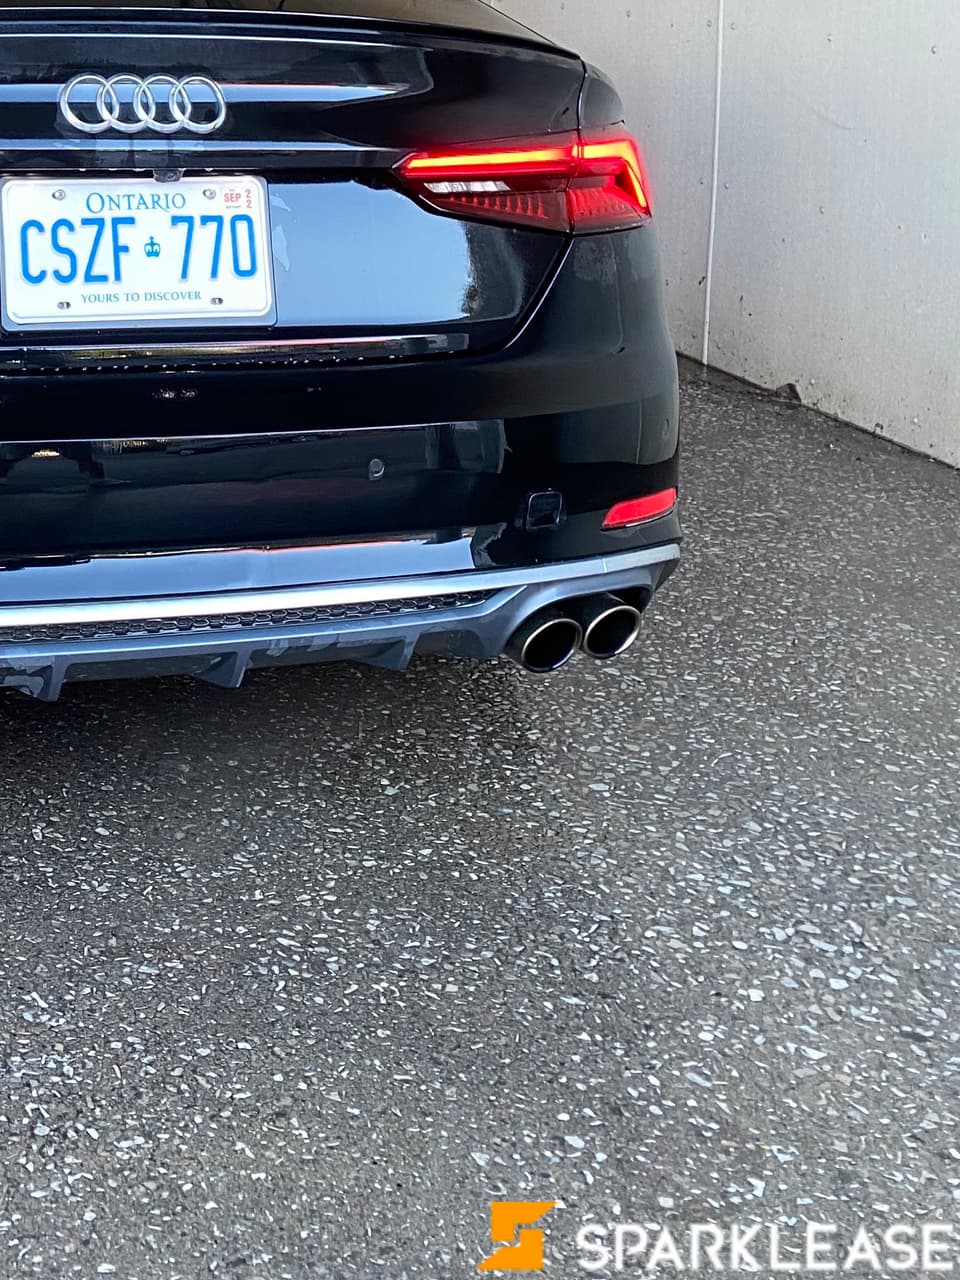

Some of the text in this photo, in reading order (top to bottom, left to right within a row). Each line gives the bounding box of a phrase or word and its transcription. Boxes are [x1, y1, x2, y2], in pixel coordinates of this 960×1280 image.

[86, 192, 186, 213] ONTARIO
[224, 193, 241, 202] SEP
[20, 214, 258, 284] CSZF 770
[81, 291, 202, 303] YOURS TO DISCOVER
